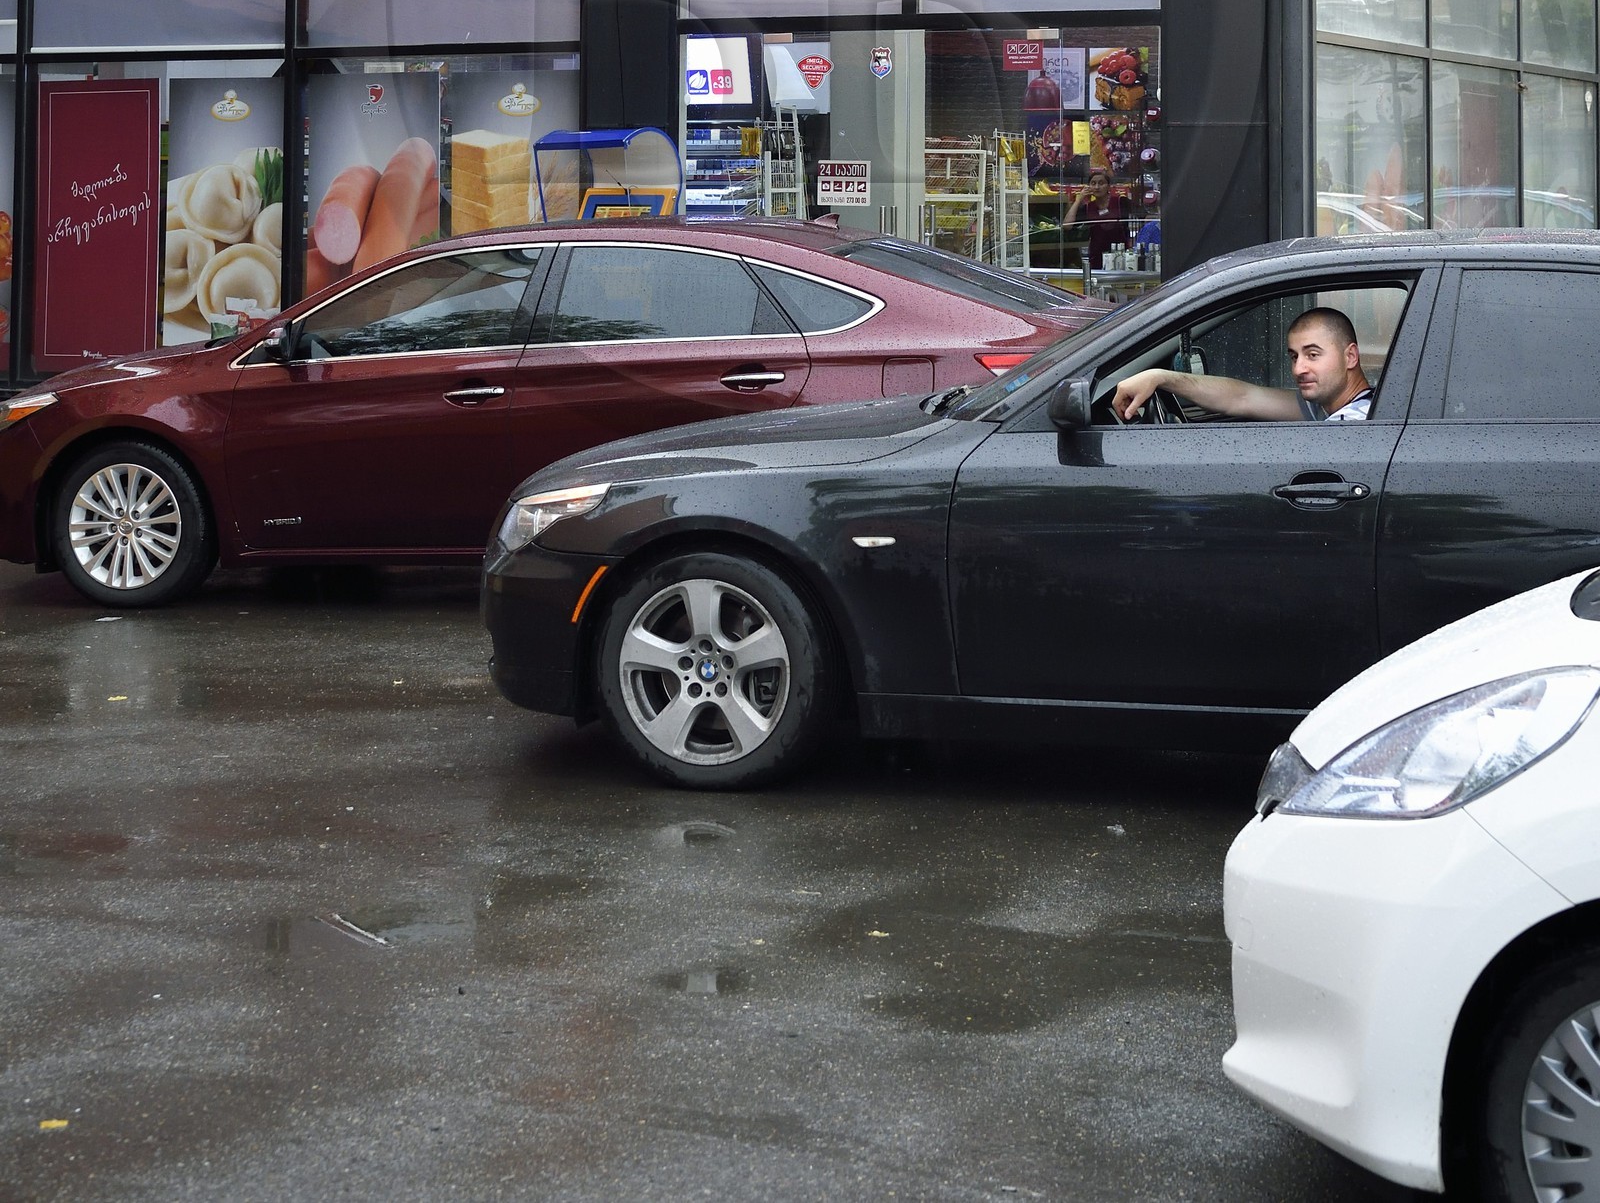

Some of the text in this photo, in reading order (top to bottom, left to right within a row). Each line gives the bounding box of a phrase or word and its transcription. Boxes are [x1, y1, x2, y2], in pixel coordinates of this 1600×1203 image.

[71, 163, 127, 202] მადლობა
[820, 164, 866, 177] 24 საათი
[48, 192, 151, 245] არჩევანისთვის
